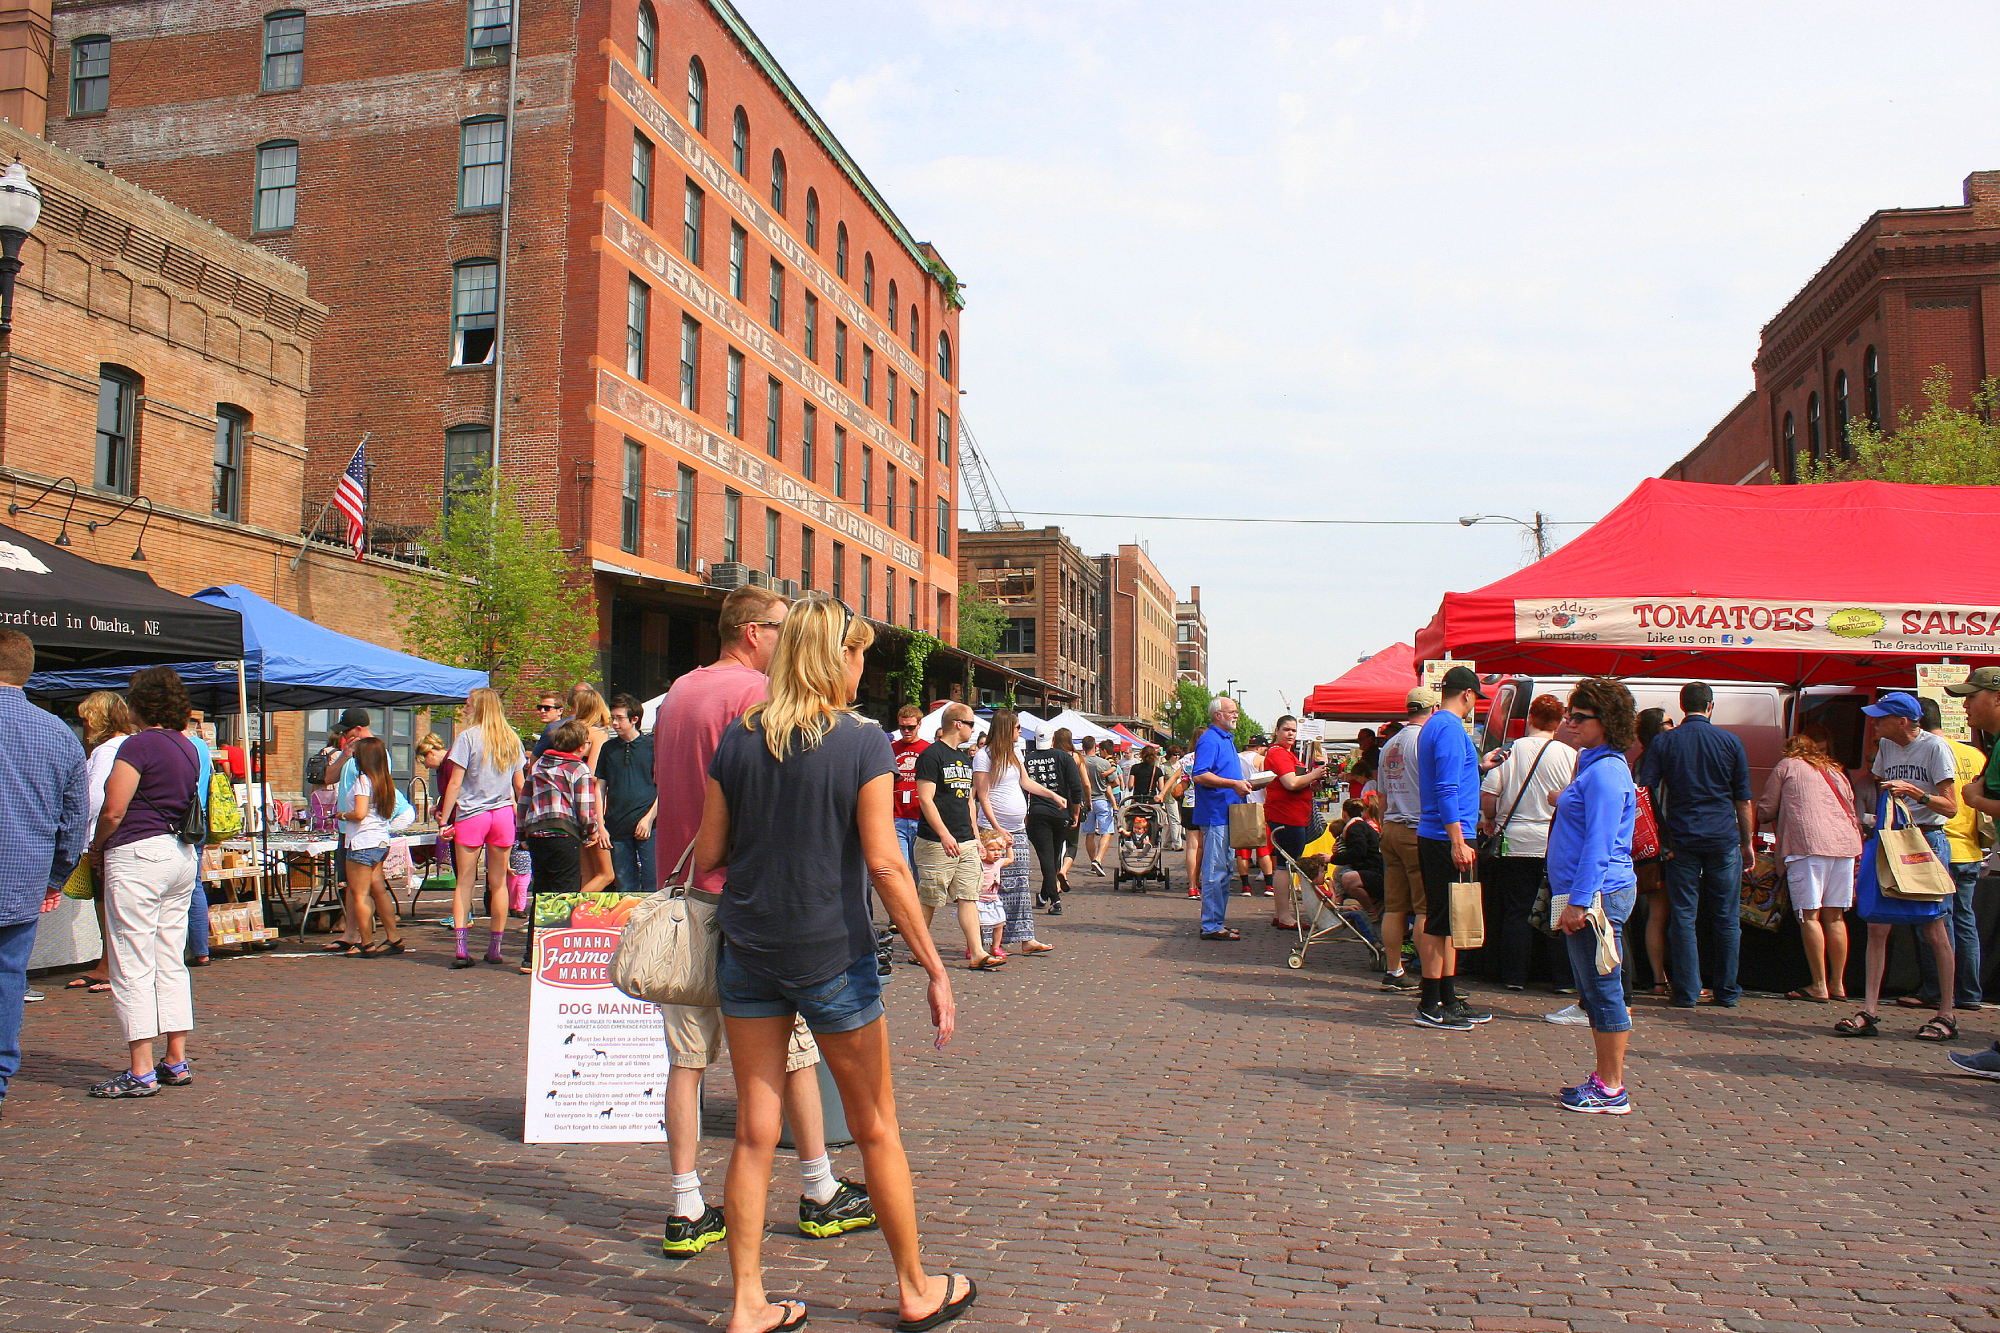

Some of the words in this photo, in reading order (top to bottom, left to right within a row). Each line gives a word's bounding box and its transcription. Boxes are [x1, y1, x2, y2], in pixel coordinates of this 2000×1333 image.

[684, 136, 757, 222] UNION
[620, 221, 776, 361] FURNITURE
[801, 364, 849, 417] RUGS
[616, 387, 763, 486] COMPLETE
[769, 469, 821, 518] HOME
[825, 502, 920, 568] FURNISHERS
[1534, 600, 1598, 622] Graddy's
[66, 613, 83, 630] in
[90, 615, 136, 636] Omaha,
[144, 620, 161, 636] NE
[1632, 604, 1815, 632] TOMATOES
[1848, 615, 1861, 624] NO
[1836, 620, 1876, 632] PESTICIDES
[1537, 629, 1598, 642] Tomatoes
[1647, 632, 1675, 645] Like
[1678, 634, 1695, 645] us
[1698, 634, 1716, 645] on
[1872, 640, 1893, 650] The
[1895, 640, 1953, 652] Gradoville
[1957, 642, 1995, 654] Family
[1028, 757, 1055, 766] OMAHA
[563, 936, 612, 948] OMAHA
[559, 967, 607, 980] MARKE
[559, 1003, 592, 1015] DOG
